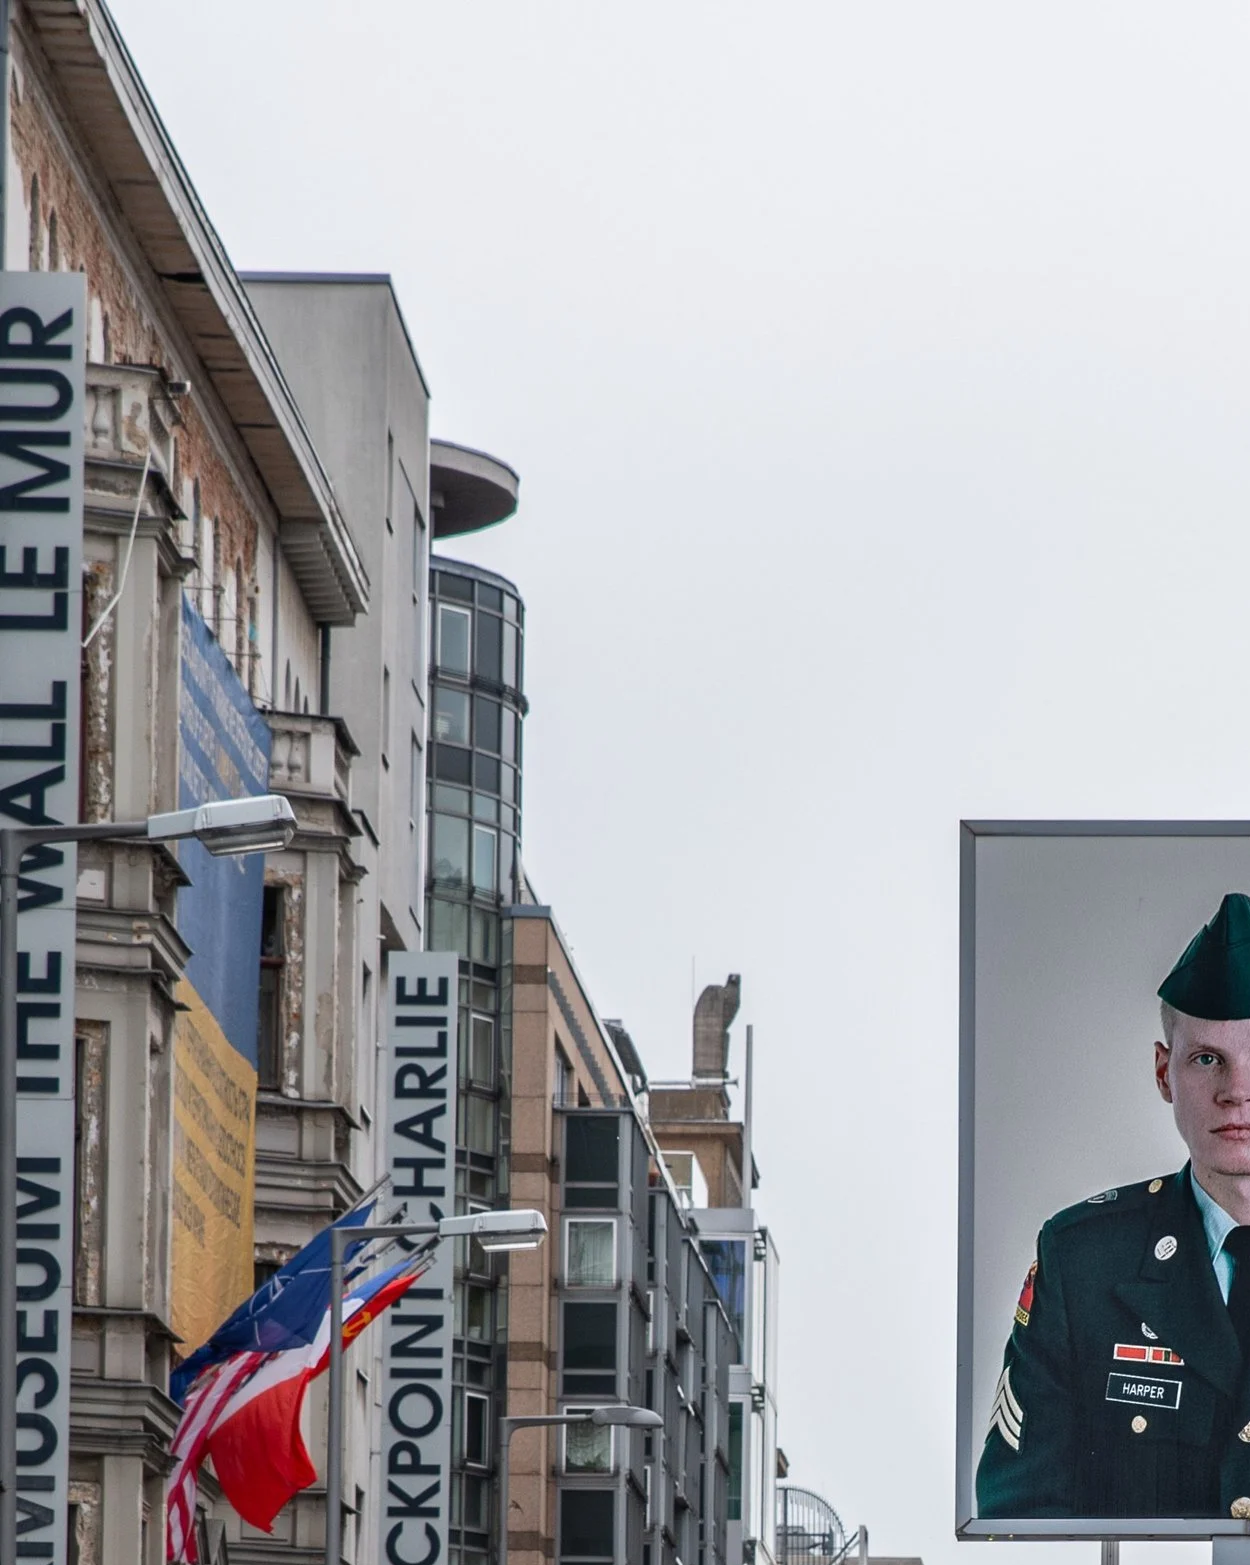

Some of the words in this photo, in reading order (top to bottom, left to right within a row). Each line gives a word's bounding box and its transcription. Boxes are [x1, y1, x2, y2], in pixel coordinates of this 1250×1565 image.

[0, 306, 74, 513] MUR
[0, 545, 70, 631] LE
[393, 975, 449, 1254] CHARLIE
[1122, 1383, 1165, 1399] HARPER
